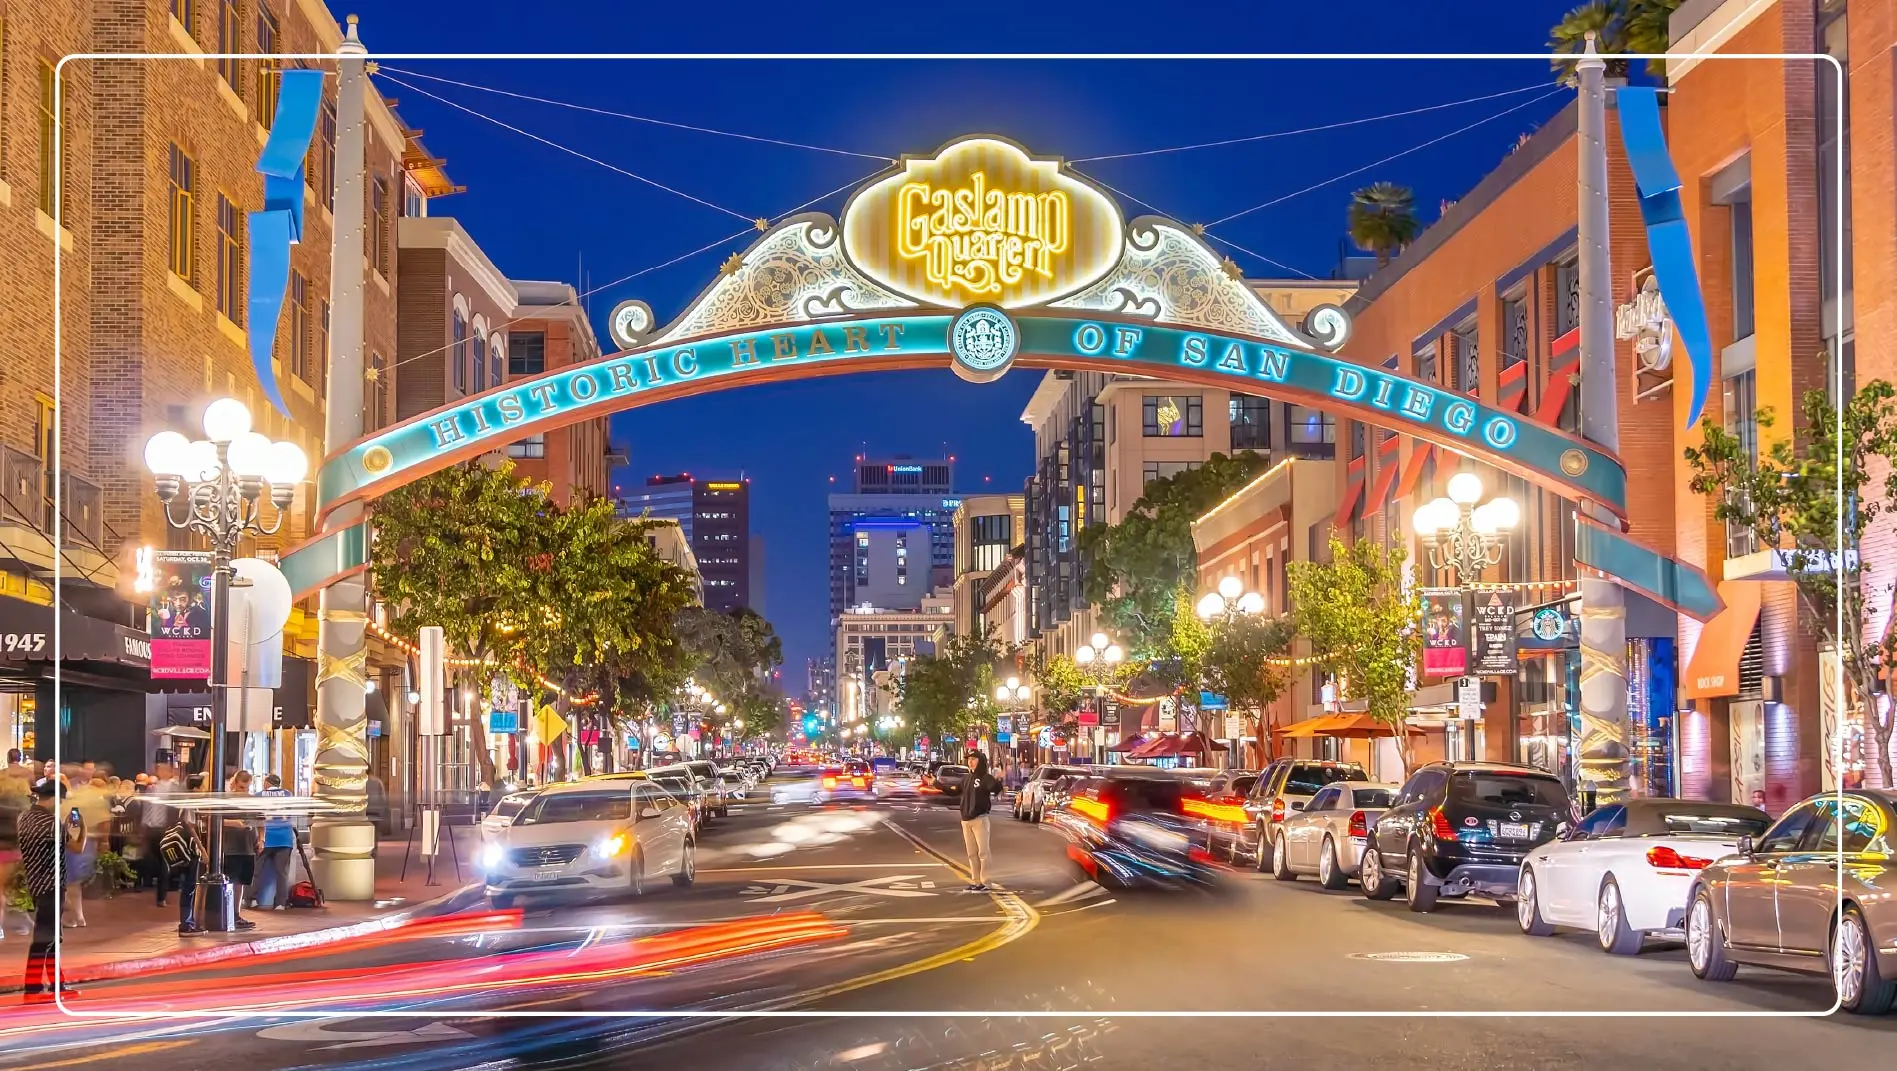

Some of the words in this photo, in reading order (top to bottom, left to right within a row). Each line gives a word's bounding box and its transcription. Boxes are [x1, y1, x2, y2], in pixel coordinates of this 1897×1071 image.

[898, 172, 1069, 259] Gaslamp
[926, 228, 1053, 293] Quarter
[430, 348, 698, 447] HISTORIC
[728, 323, 905, 368] HEART
[1077, 325, 1141, 355] OF
[1183, 337, 1290, 379] SAN
[1334, 368, 1516, 446] DIEGO
[1476, 606, 1515, 615] WCKD
[161, 627, 201, 635] WCKD
[0, 633, 46, 652] 1945
[124, 636, 152, 660] FAMOUS
[974, 778, 981, 788] S
